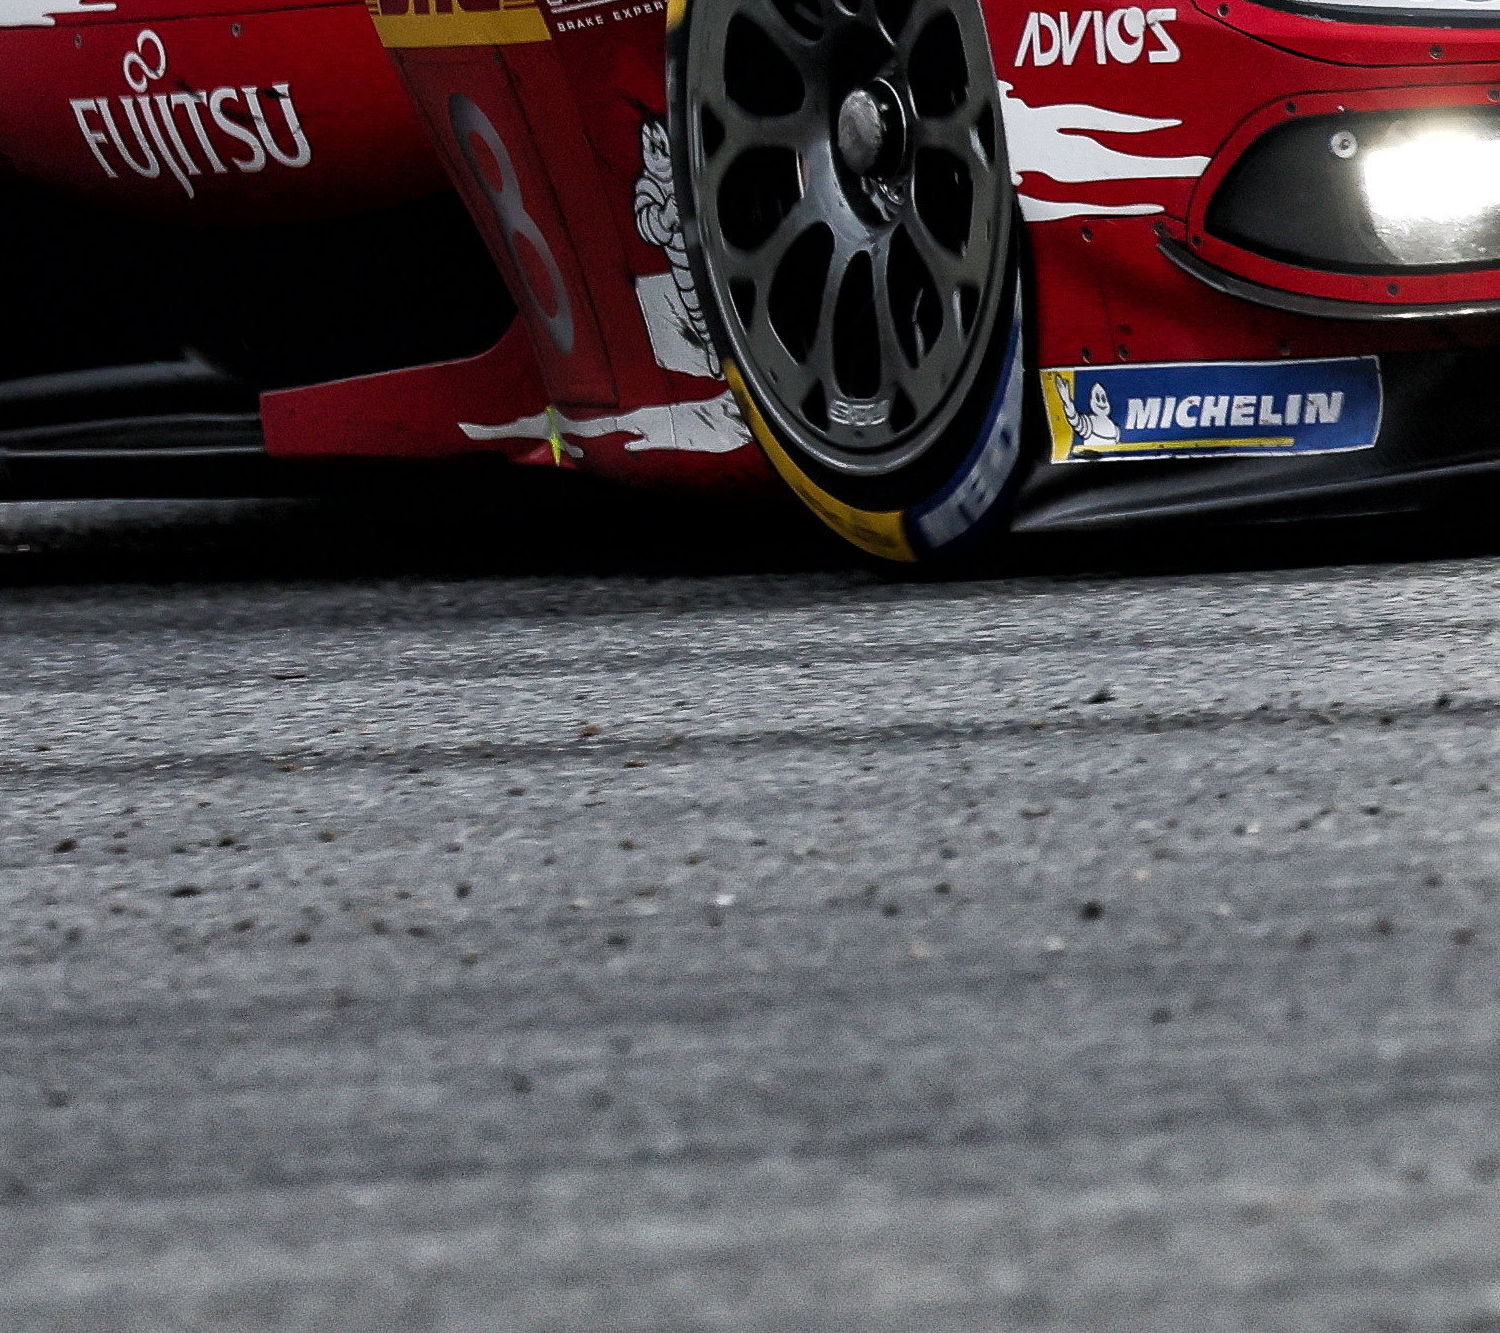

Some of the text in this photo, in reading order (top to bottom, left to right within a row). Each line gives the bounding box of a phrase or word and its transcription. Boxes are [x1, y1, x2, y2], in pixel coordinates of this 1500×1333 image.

[556, 14, 605, 33] BRAKE
[1014, 5, 1181, 68] ADVICS
[68, 81, 312, 200] FUJITSU
[449, 92, 575, 356] 8
[1124, 390, 1345, 431] MICHELIN
